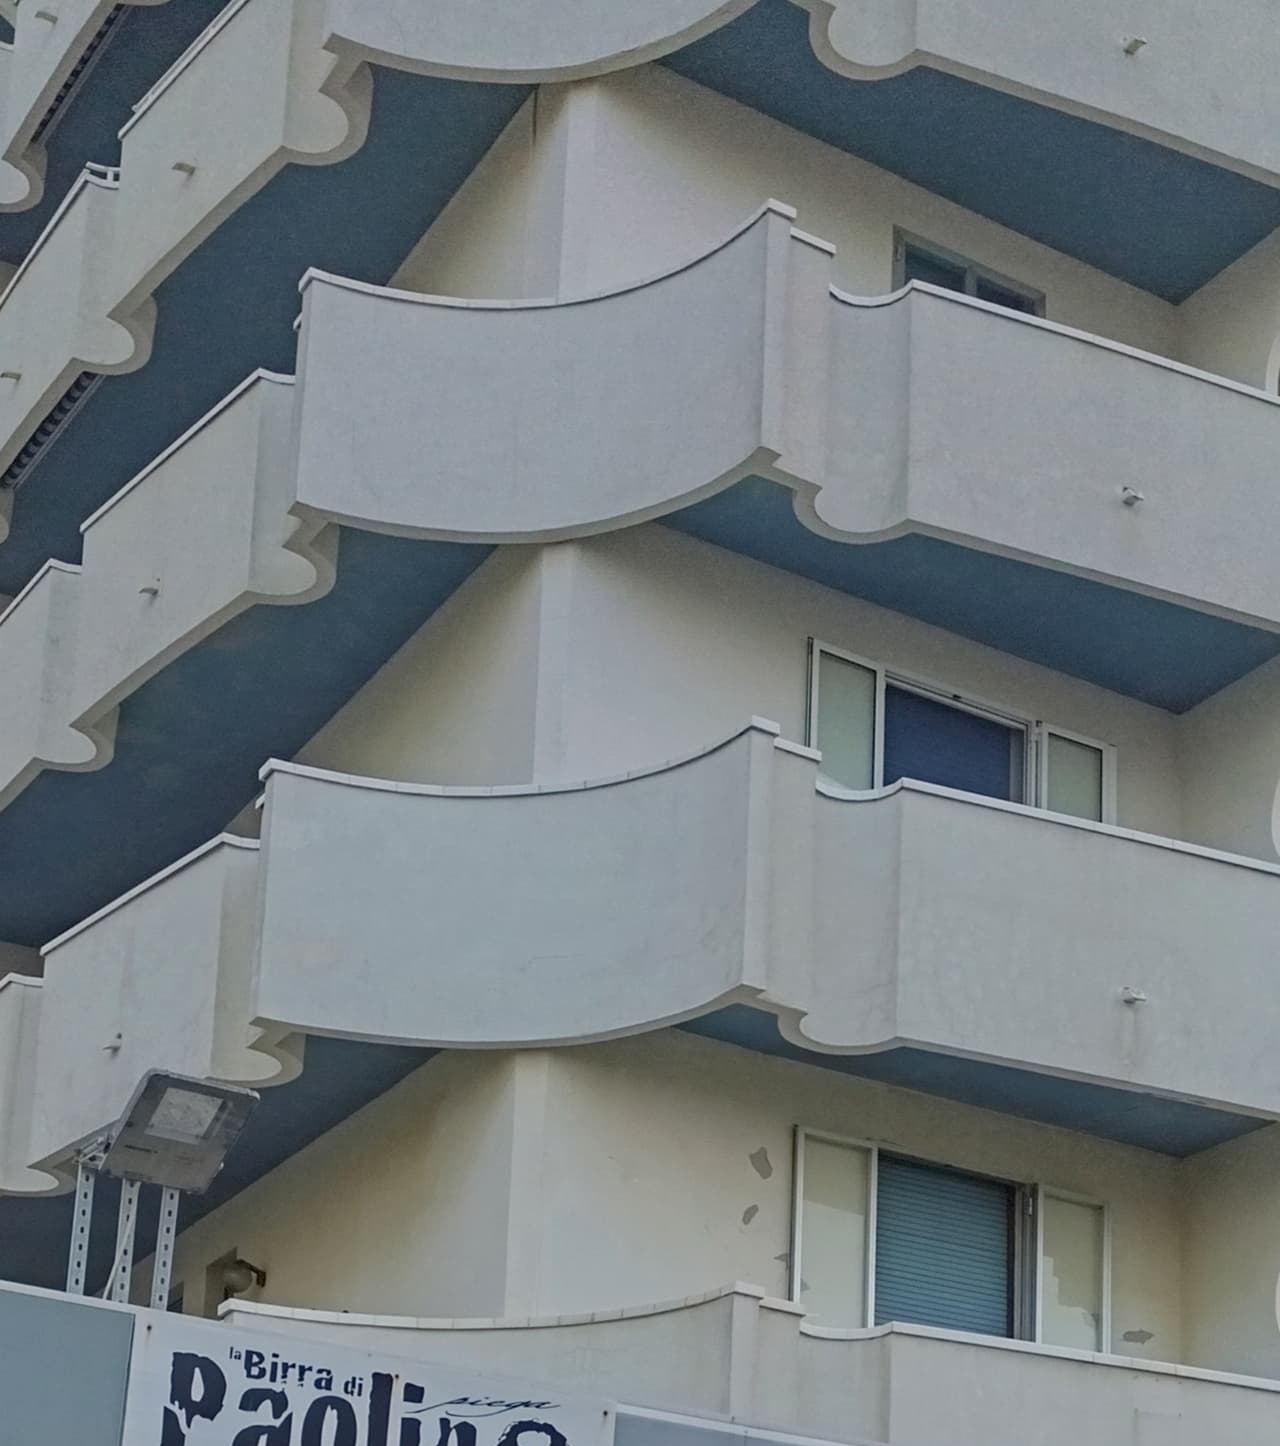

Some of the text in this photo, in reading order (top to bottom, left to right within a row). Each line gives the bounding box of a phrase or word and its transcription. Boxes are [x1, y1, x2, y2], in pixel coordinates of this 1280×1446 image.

[229, 1346, 364, 1397] la Birra di
